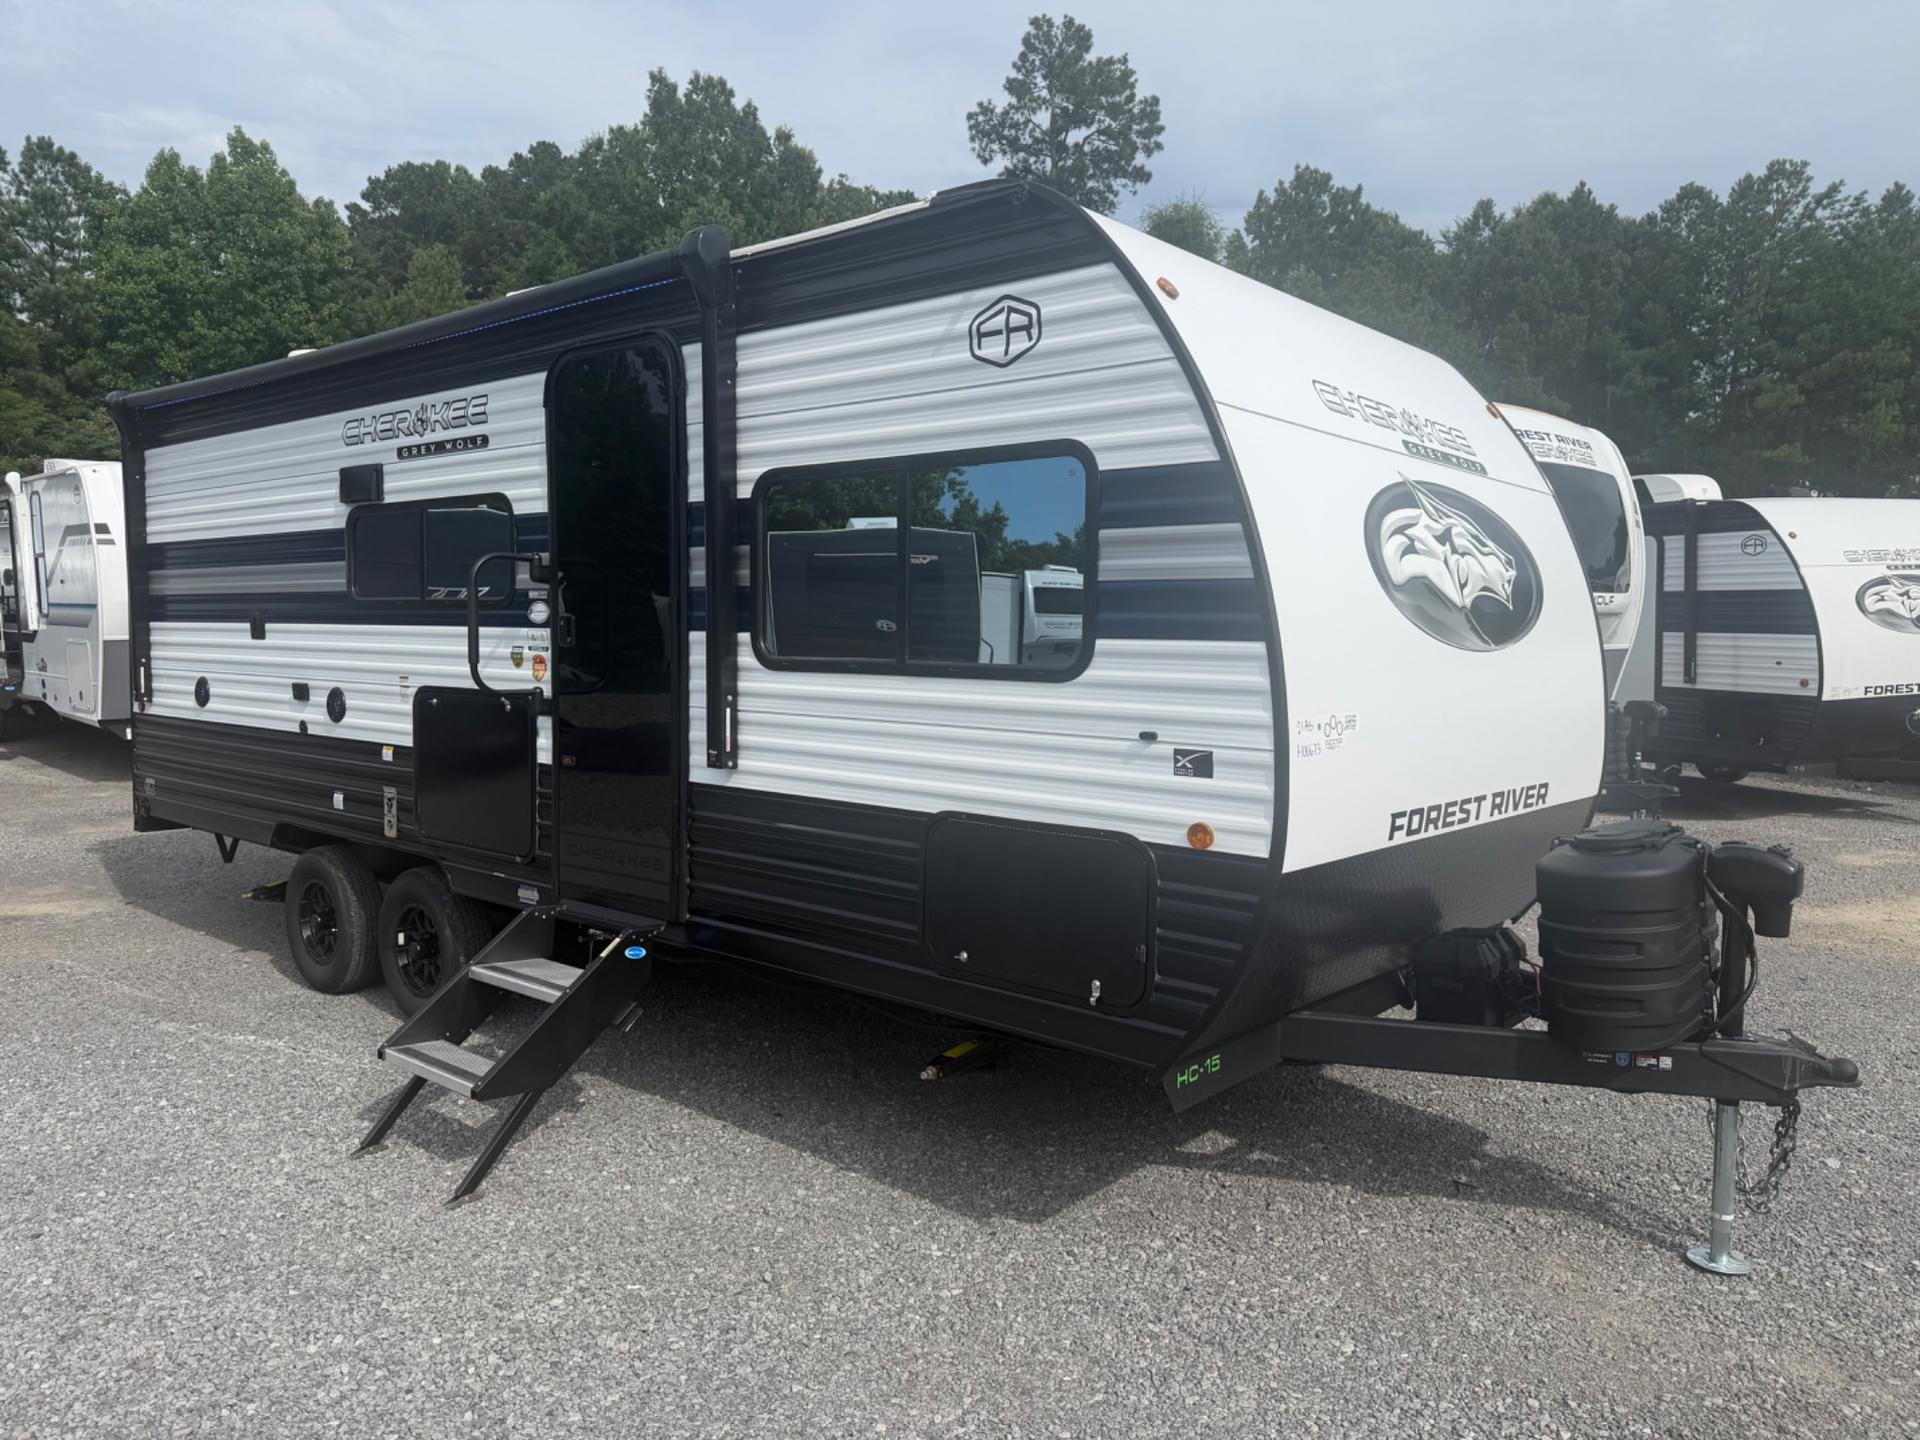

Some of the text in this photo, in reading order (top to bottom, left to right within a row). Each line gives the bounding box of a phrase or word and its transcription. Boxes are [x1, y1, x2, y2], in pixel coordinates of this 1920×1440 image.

[401, 436, 484, 458] GREY WOLF
[1554, 435, 1594, 452] RIVER
[1448, 455, 1484, 473] WOLF
[1594, 595, 1615, 606] OLF
[1388, 782, 1549, 841] FOREST RIVER
